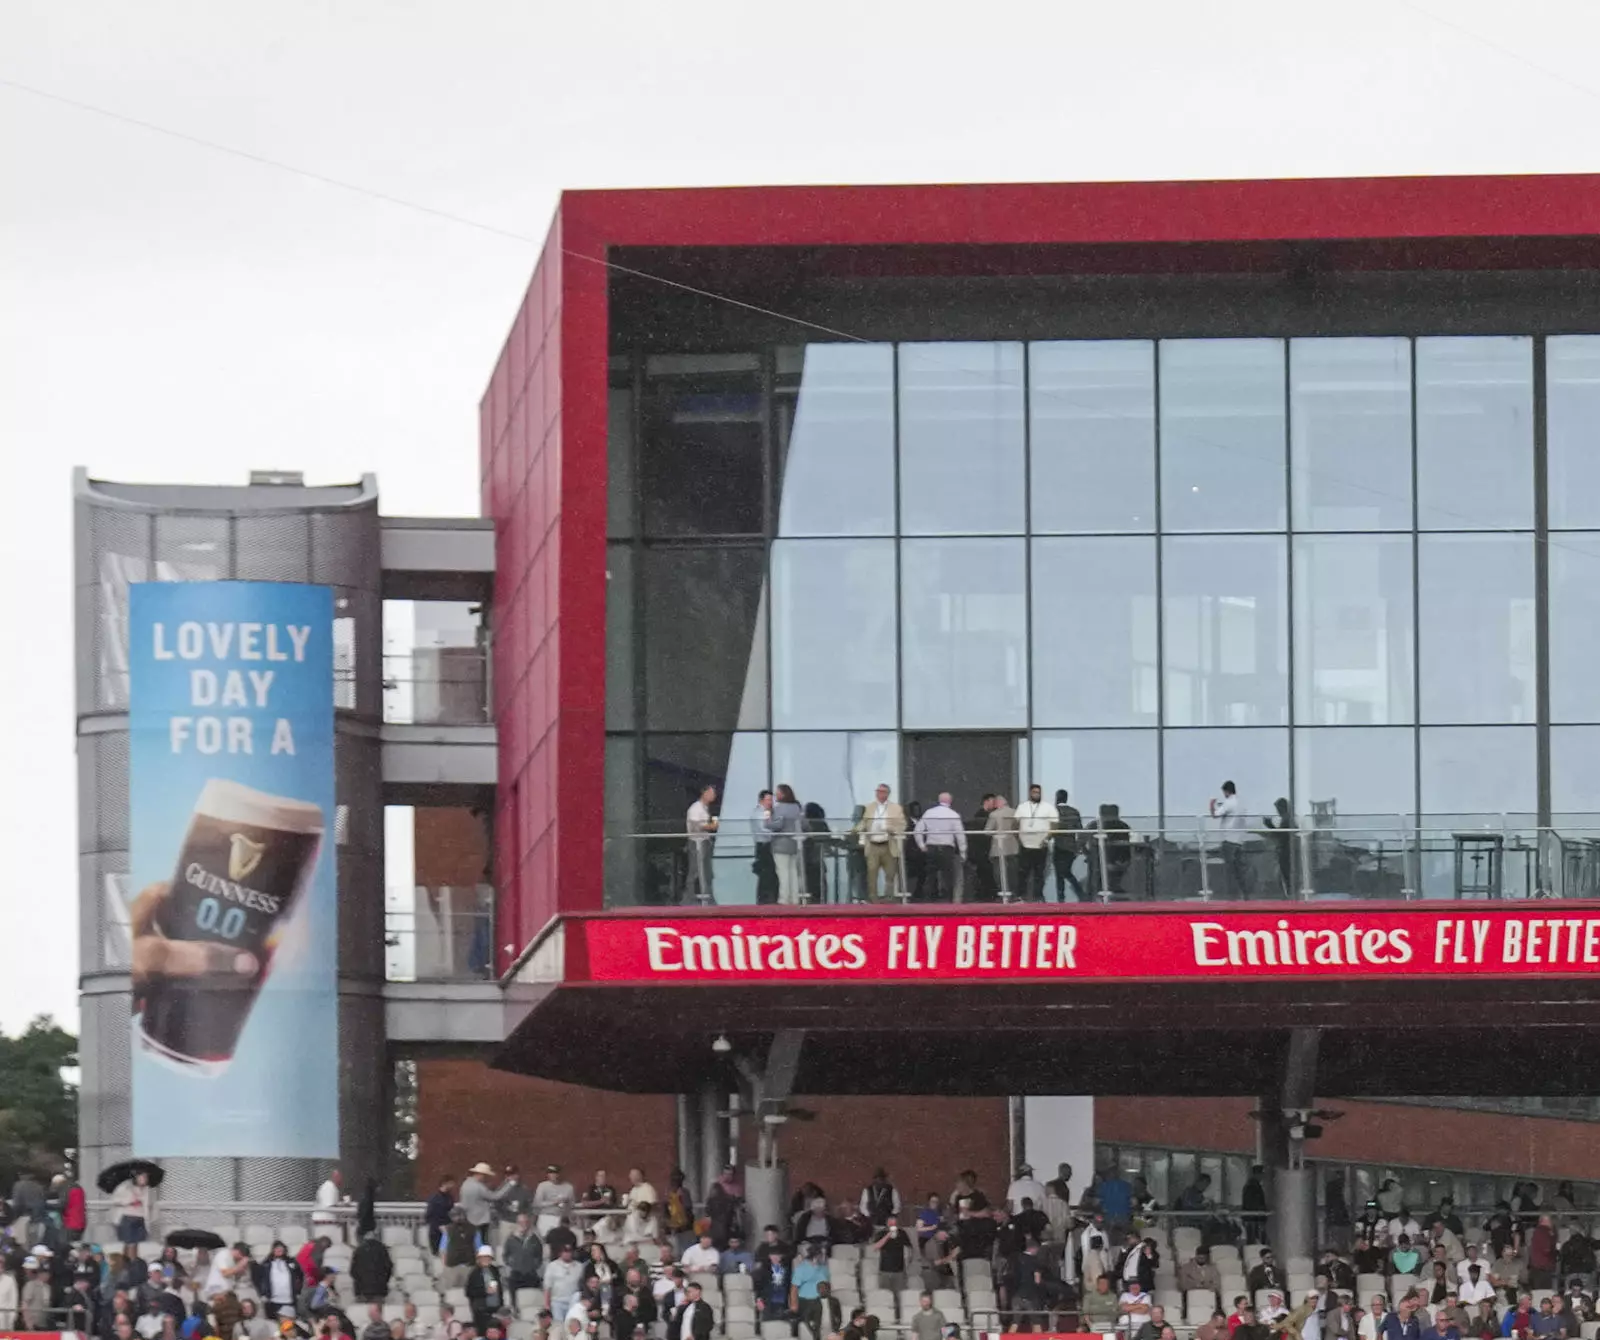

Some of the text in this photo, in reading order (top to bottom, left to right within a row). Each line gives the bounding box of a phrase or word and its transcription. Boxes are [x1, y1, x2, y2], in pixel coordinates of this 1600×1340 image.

[153, 621, 310, 661] LOVELY
[189, 668, 273, 709] DAY
[170, 716, 295, 755] FOR A
[185, 862, 279, 913] GUINNESS
[196, 897, 247, 939] 0.0
[645, 925, 1077, 970] Emirates FLY BETTER
[1191, 920, 1412, 965] Emirates
[1434, 920, 1490, 963] FLY
